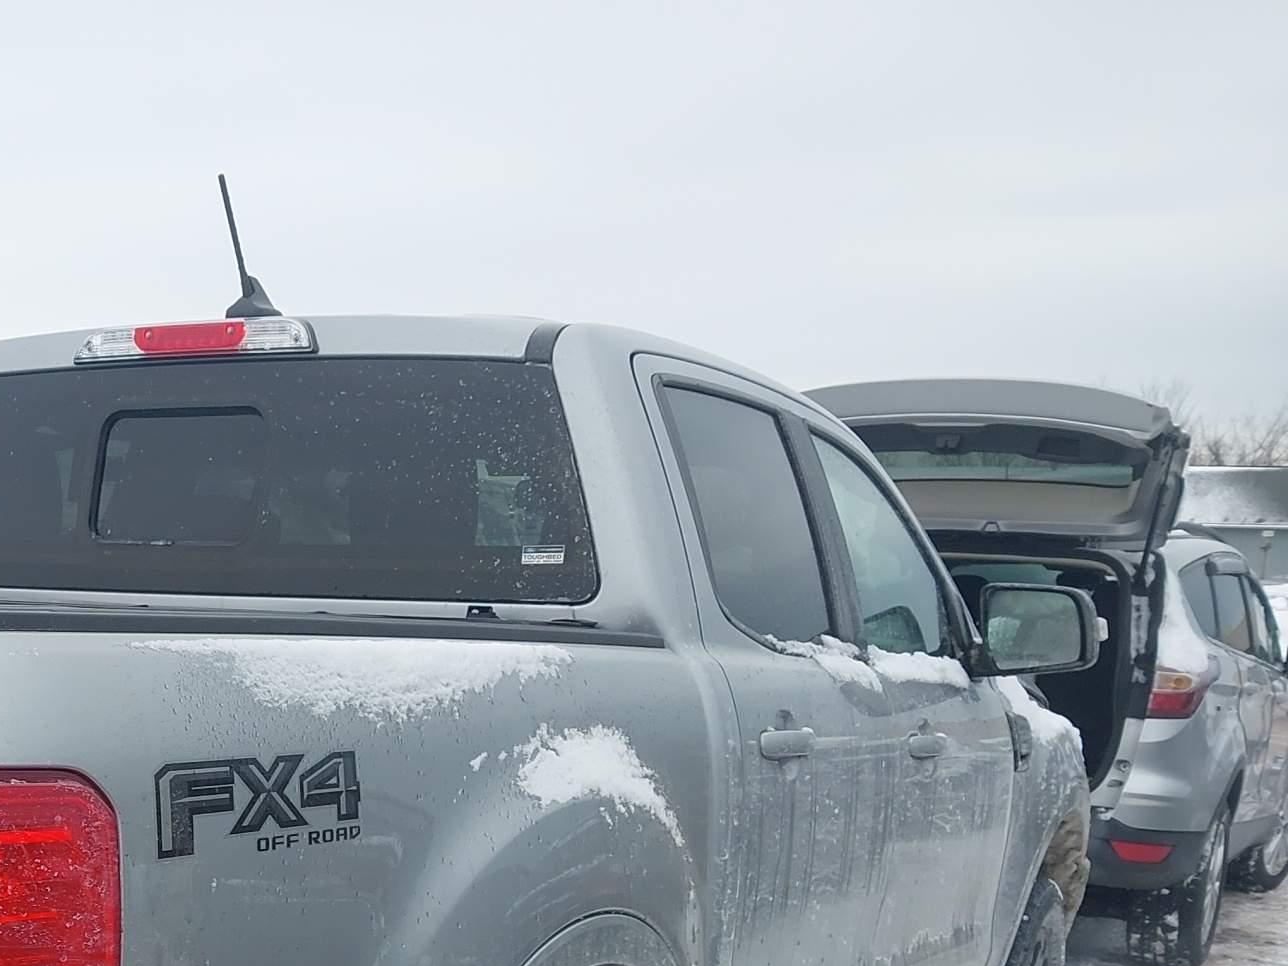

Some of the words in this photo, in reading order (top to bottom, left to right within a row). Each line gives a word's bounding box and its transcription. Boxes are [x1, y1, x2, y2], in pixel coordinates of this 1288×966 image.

[154, 750, 361, 860] FX4
[256, 832, 300, 852] OFF
[307, 825, 361, 846] ROAD
